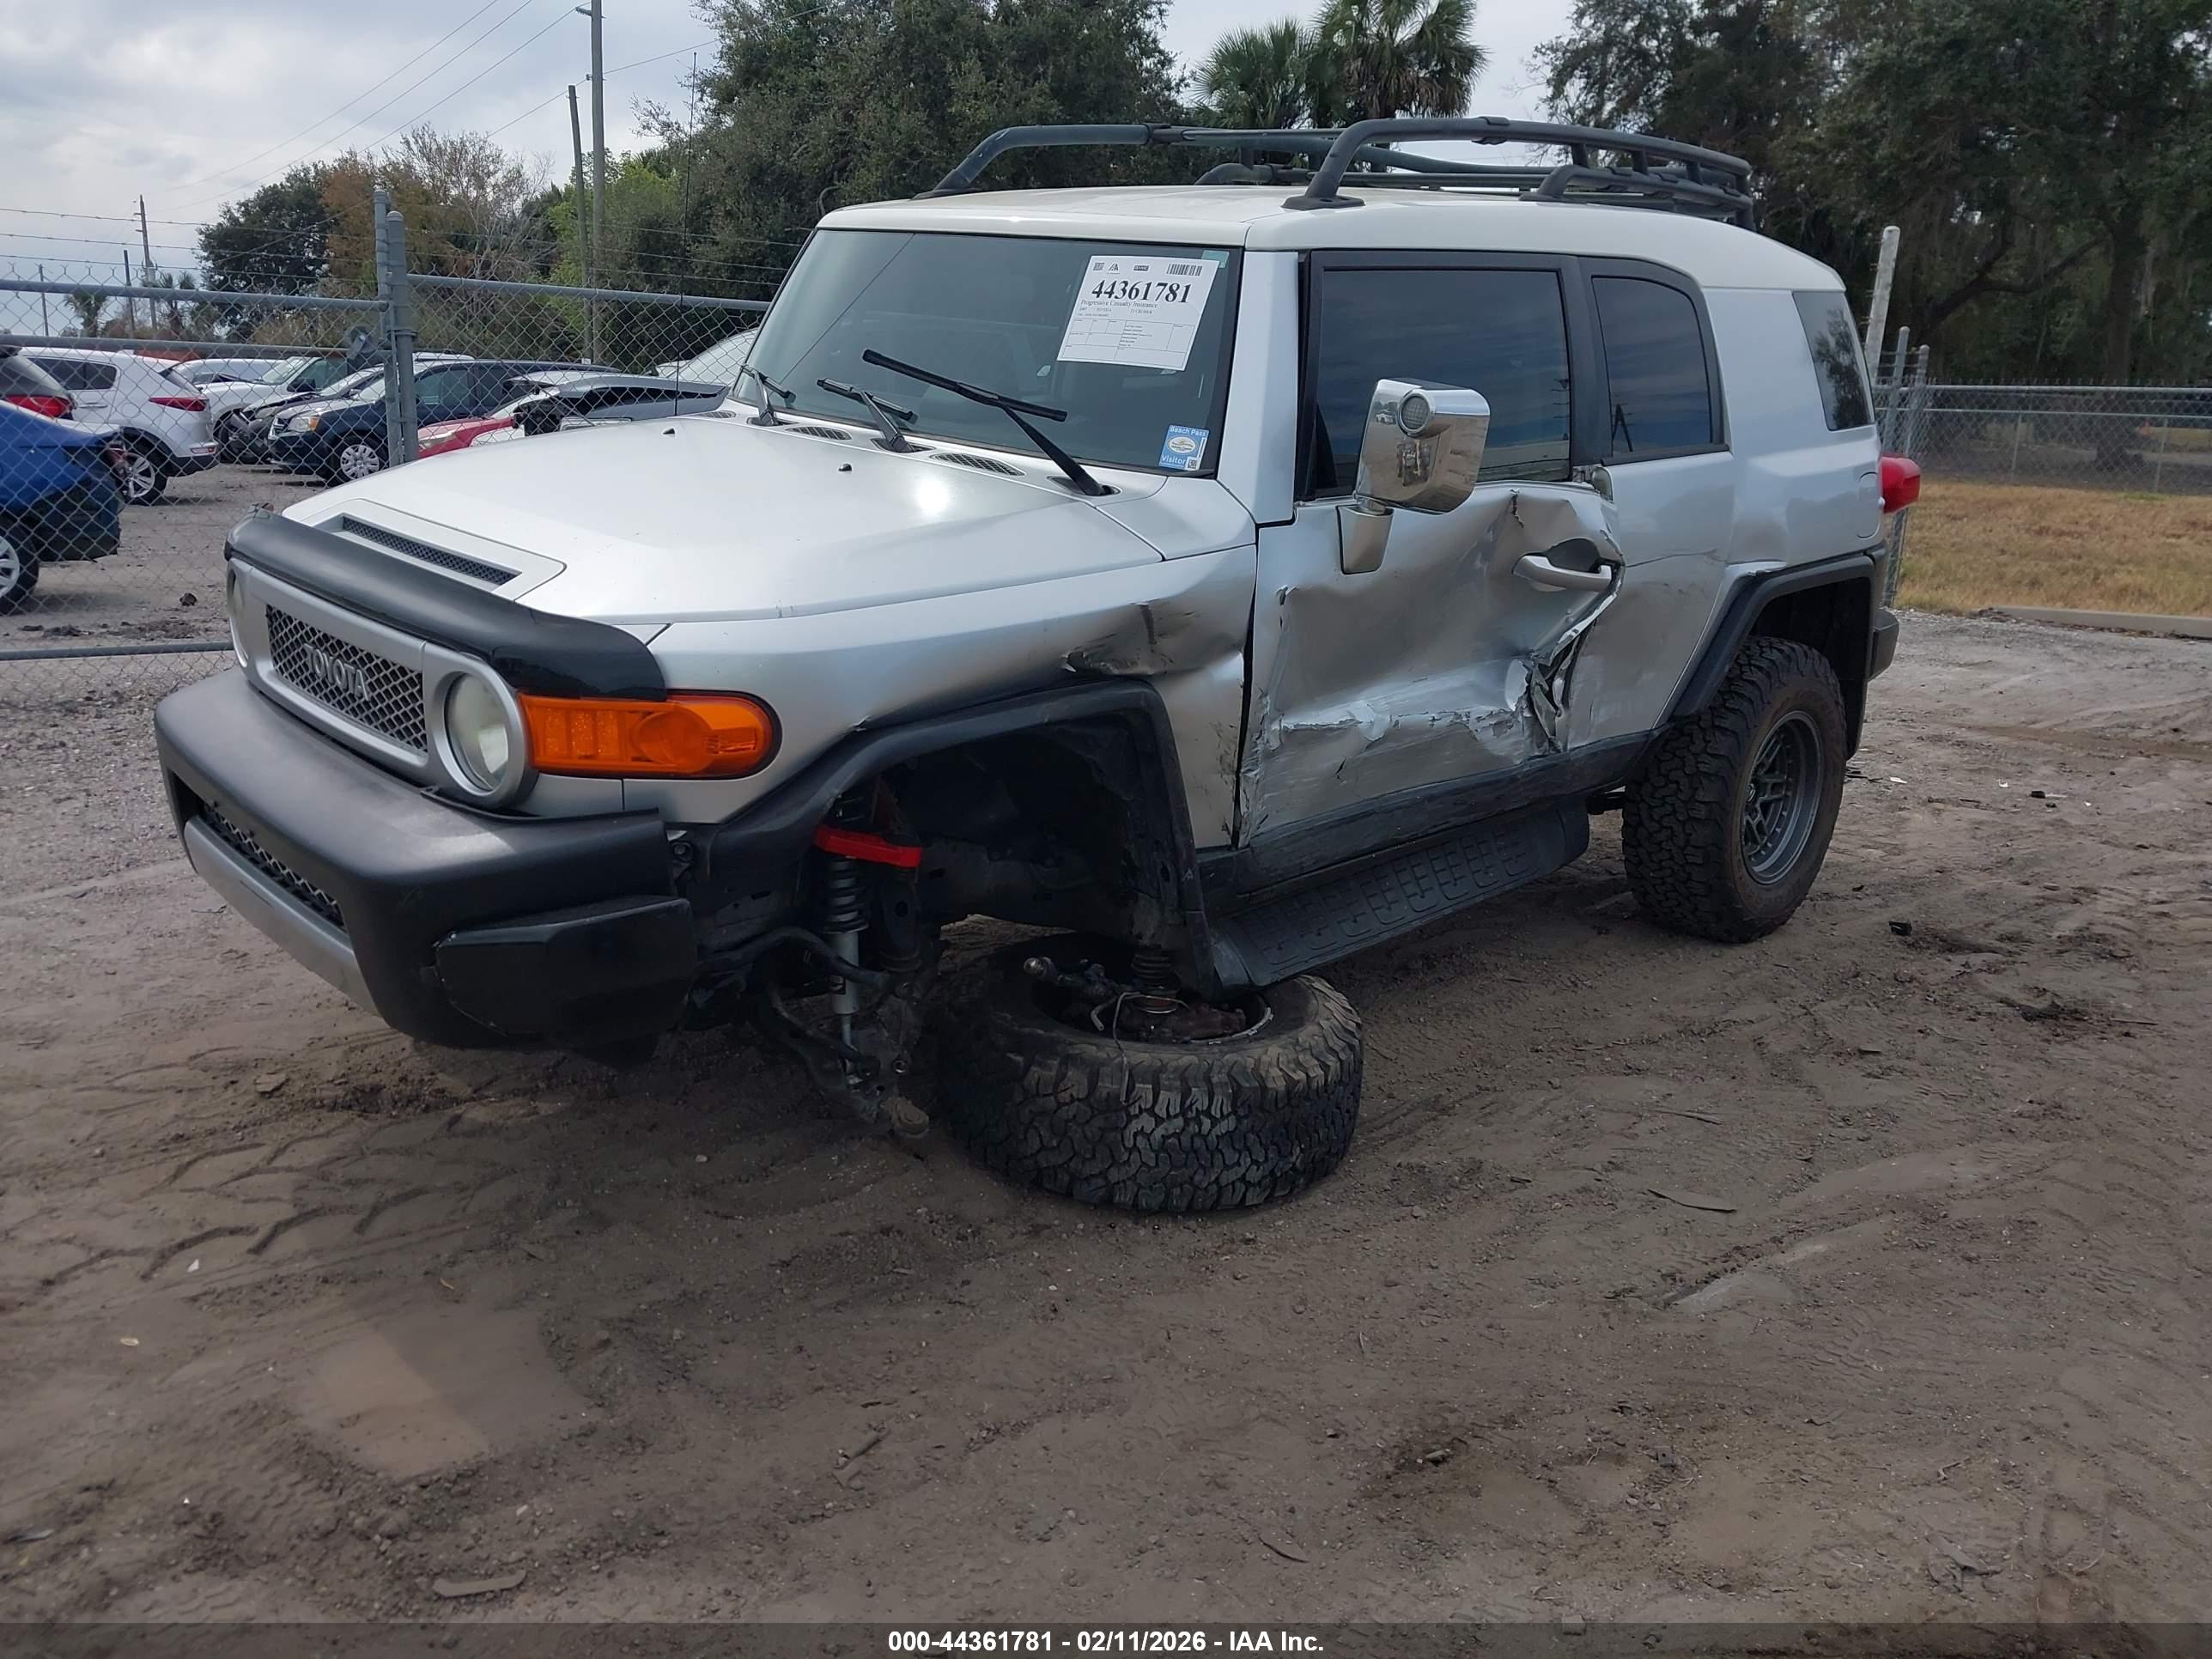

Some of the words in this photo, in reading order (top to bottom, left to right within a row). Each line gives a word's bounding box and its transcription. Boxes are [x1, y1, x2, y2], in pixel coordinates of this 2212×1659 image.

[1091, 279, 1192, 303] 44361781
[1162, 455, 1186, 465] Visitor
[304, 643, 369, 701] TOYOTA
